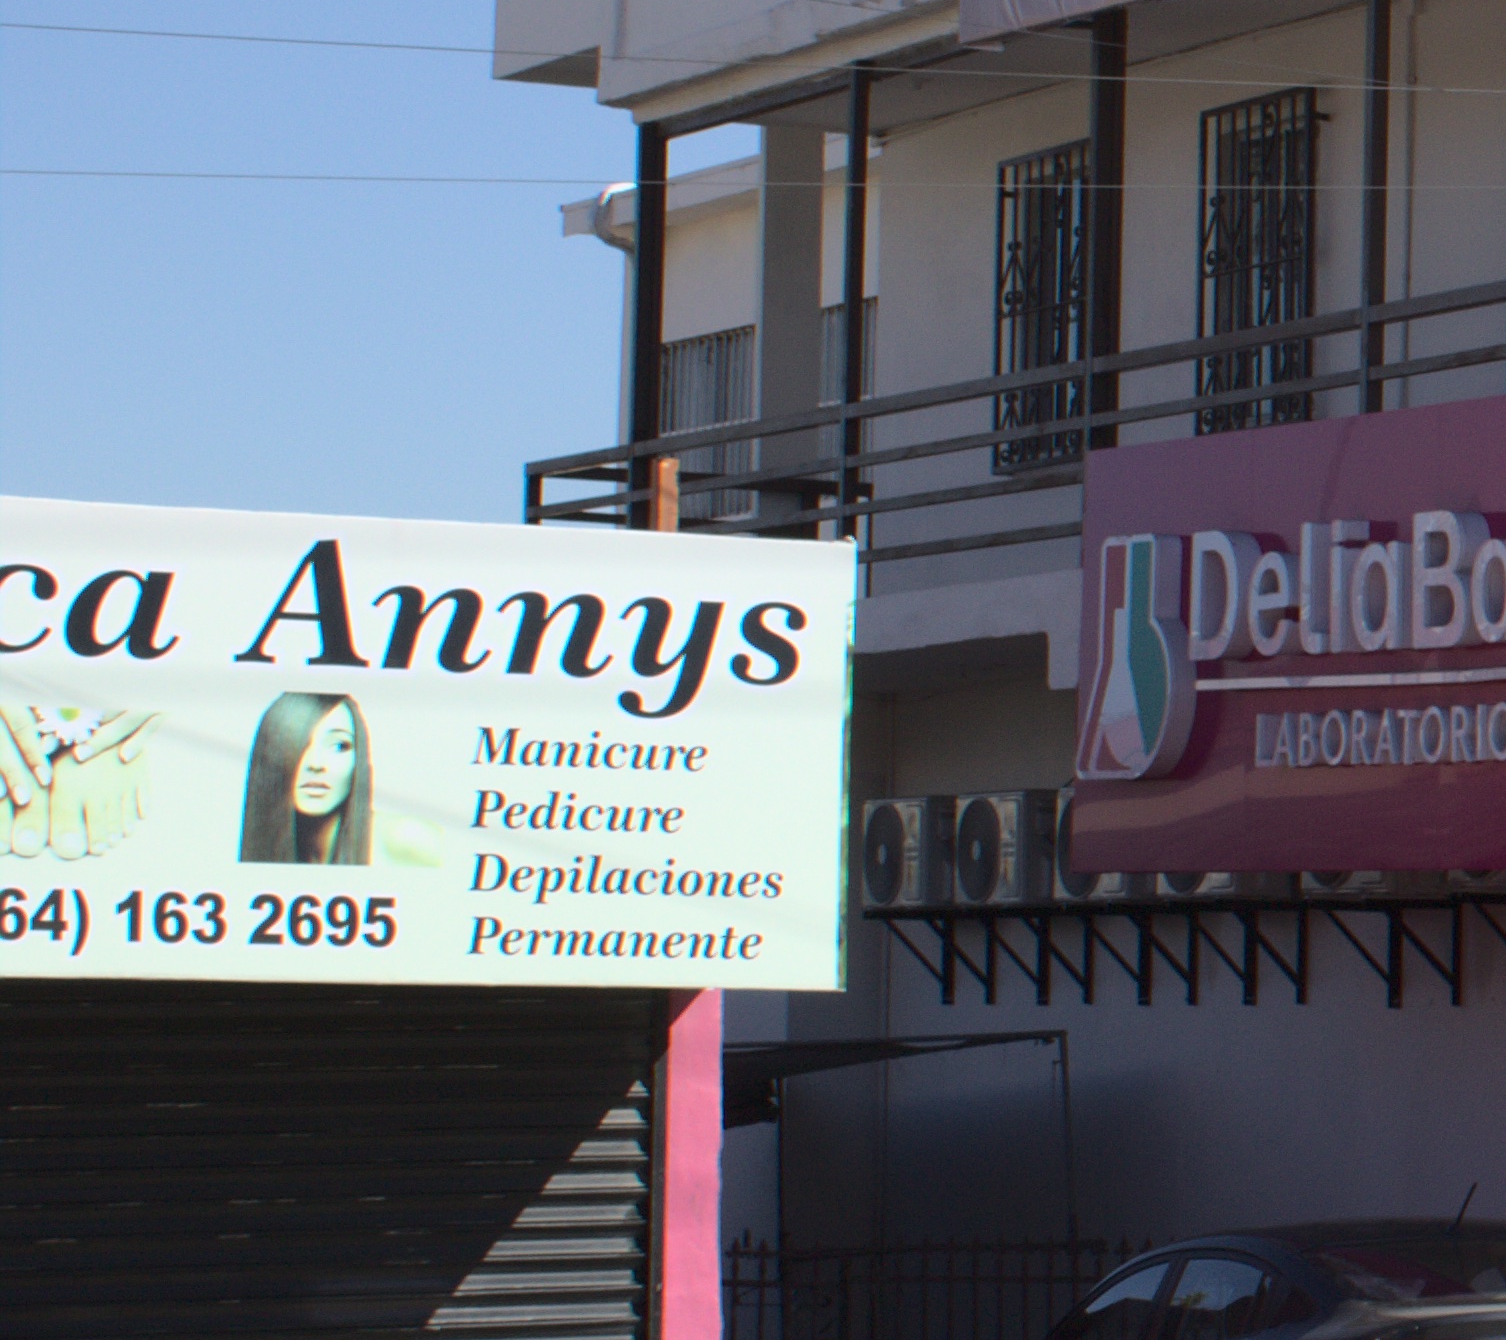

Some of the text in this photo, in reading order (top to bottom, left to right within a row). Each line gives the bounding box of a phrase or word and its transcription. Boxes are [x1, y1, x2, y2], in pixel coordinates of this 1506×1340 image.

[233, 538, 807, 719] Annys
[470, 725, 709, 773] Manicure
[468, 789, 686, 835] Pedicure
[468, 852, 784, 907] Depilaciones
[115, 889, 228, 945] 163
[247, 892, 399, 948] 2695
[467, 916, 764, 961] Permanente
